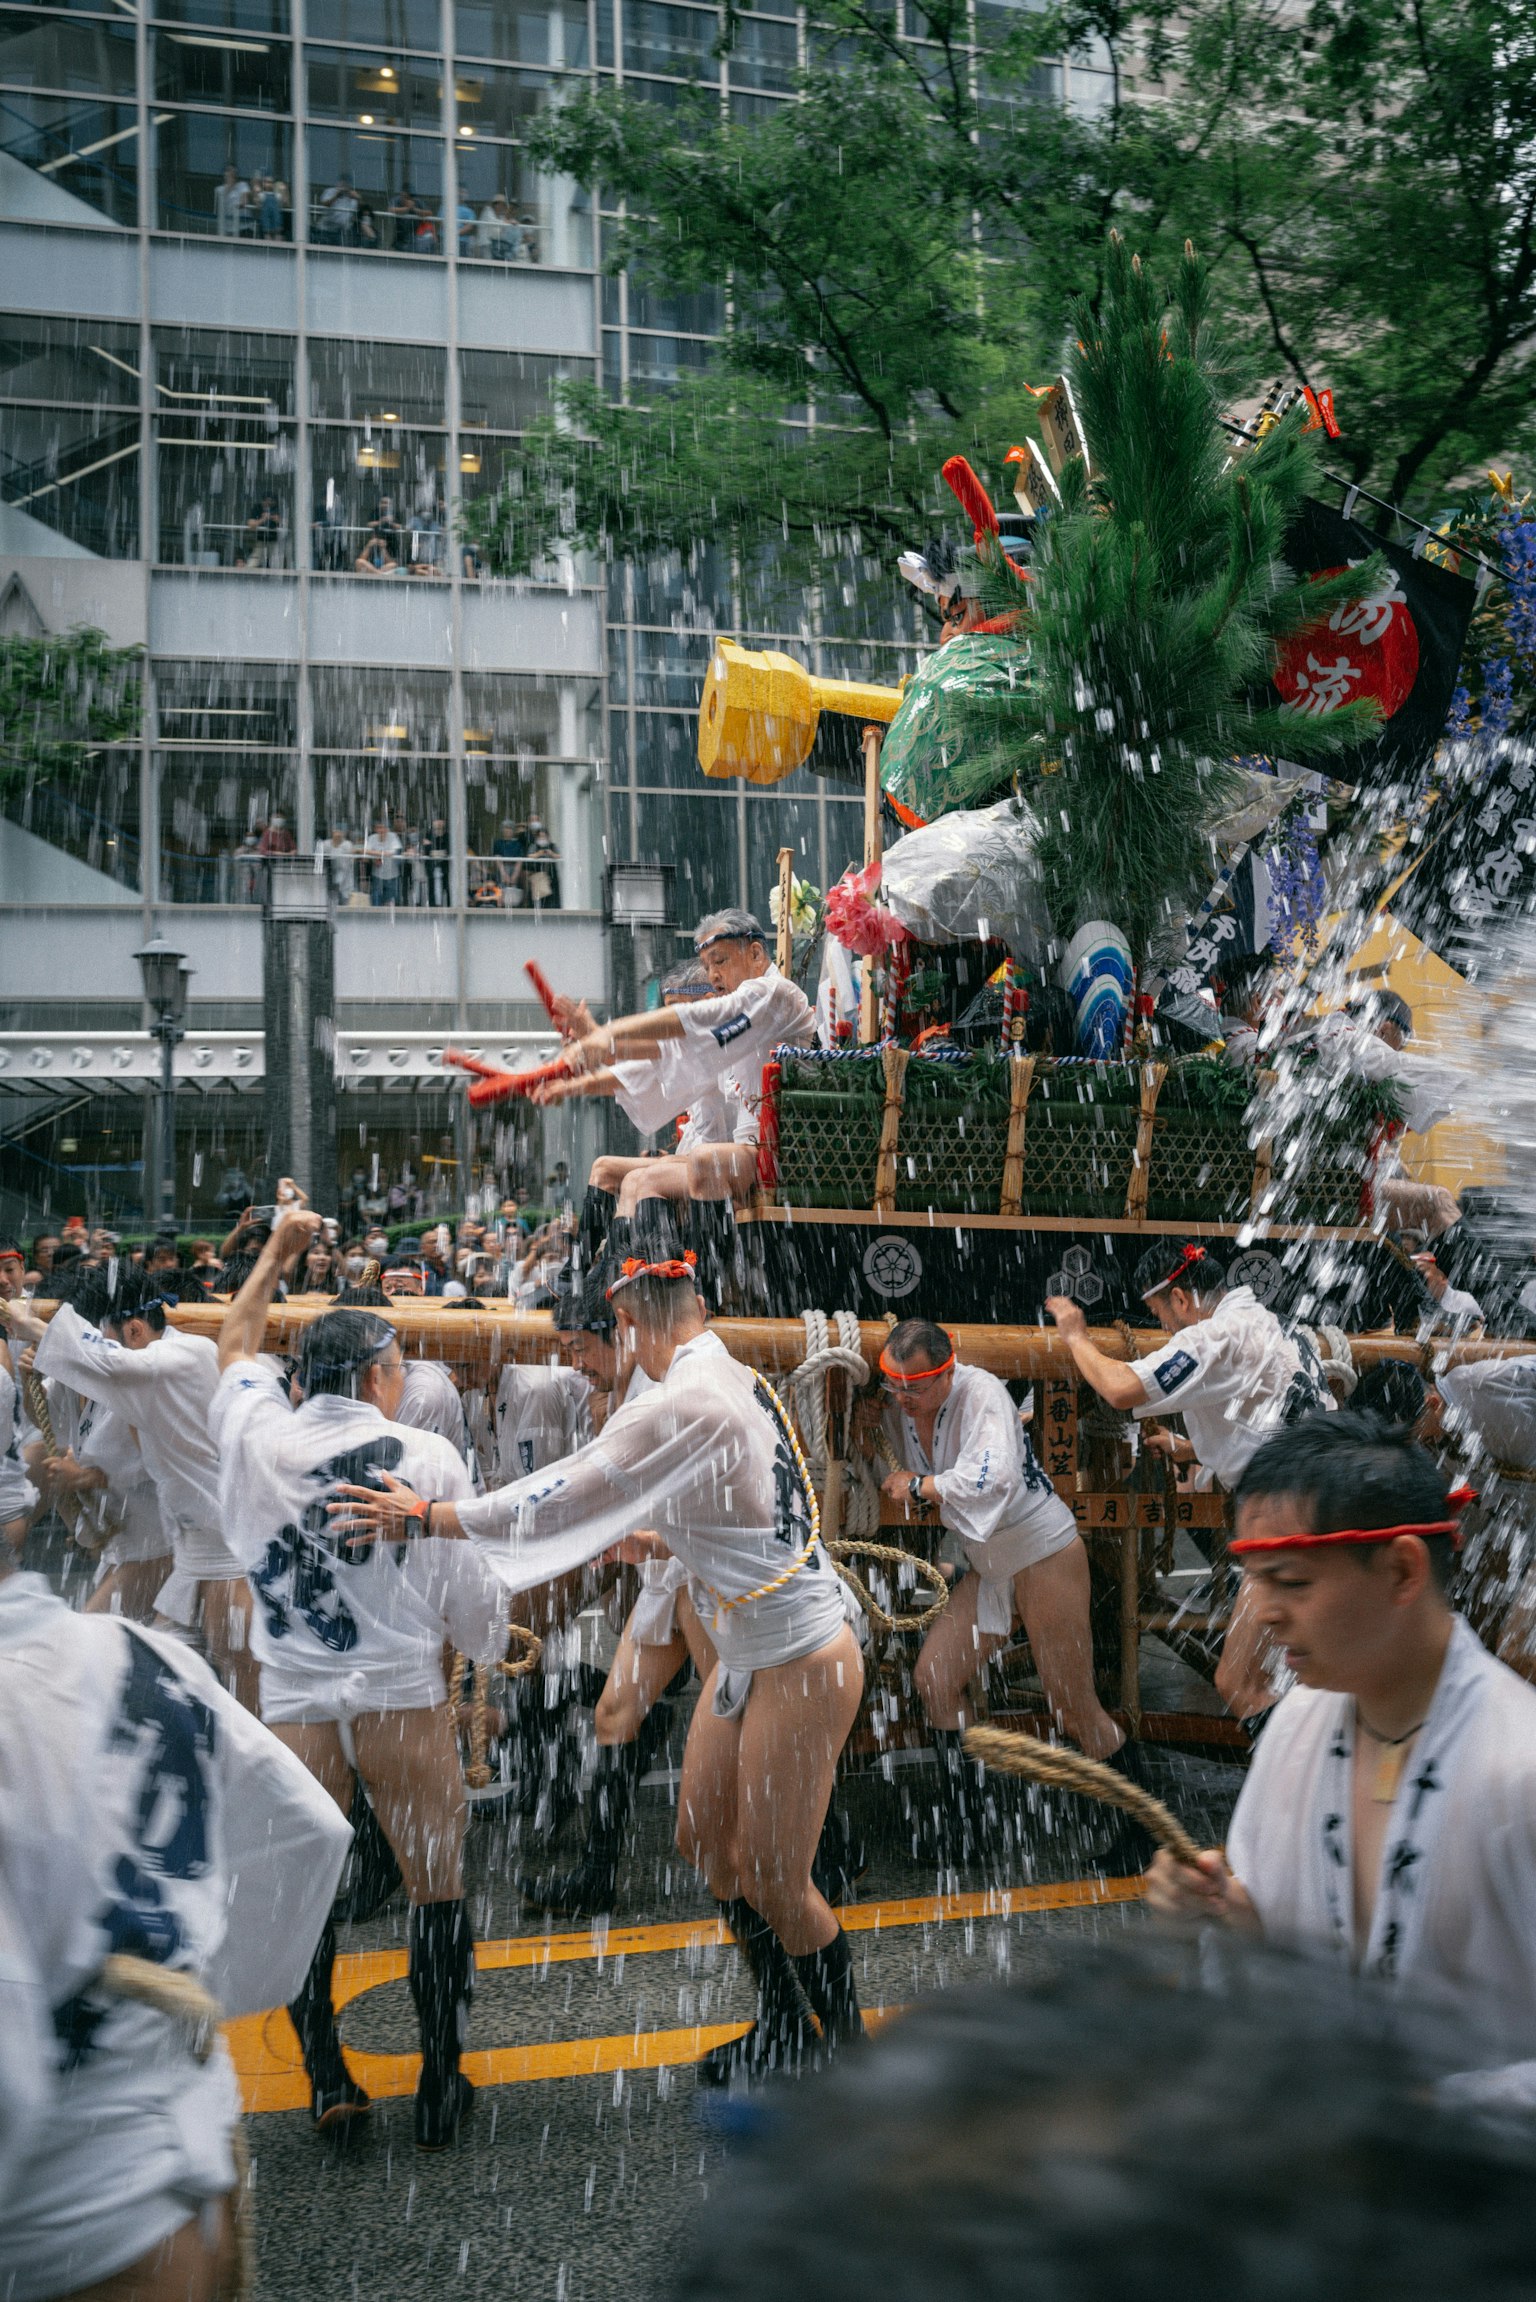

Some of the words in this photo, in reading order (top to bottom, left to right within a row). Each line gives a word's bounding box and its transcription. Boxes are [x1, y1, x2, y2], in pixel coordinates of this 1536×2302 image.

[1047, 1380, 1075, 1477] 五番山笠
[1071, 1499, 1194, 1524] 七月吉日
